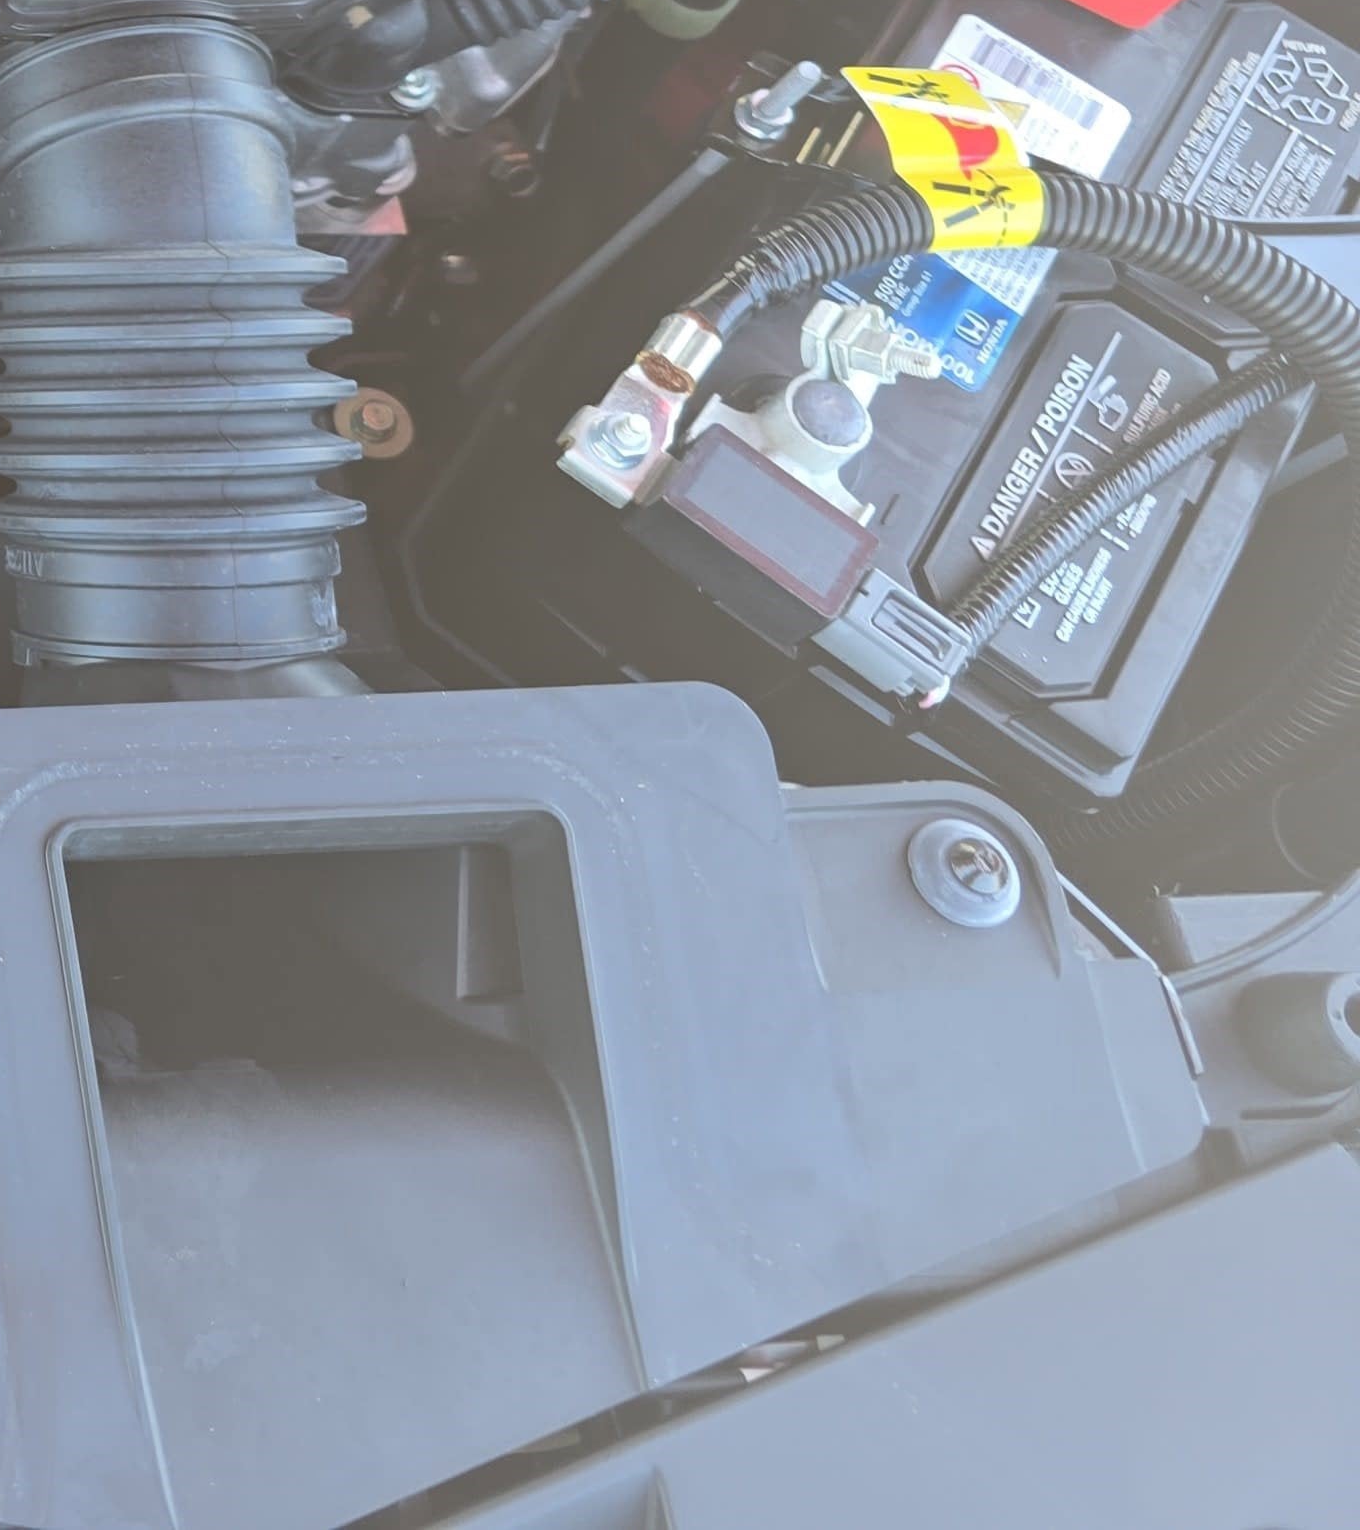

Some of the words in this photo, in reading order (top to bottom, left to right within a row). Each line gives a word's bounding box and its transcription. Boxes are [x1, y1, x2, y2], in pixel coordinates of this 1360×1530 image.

[975, 318, 1010, 363] HONDA
[1147, 368, 1173, 397] ACID
[982, 451, 1042, 535] DANGER
[1036, 357, 1093, 433] POISON
